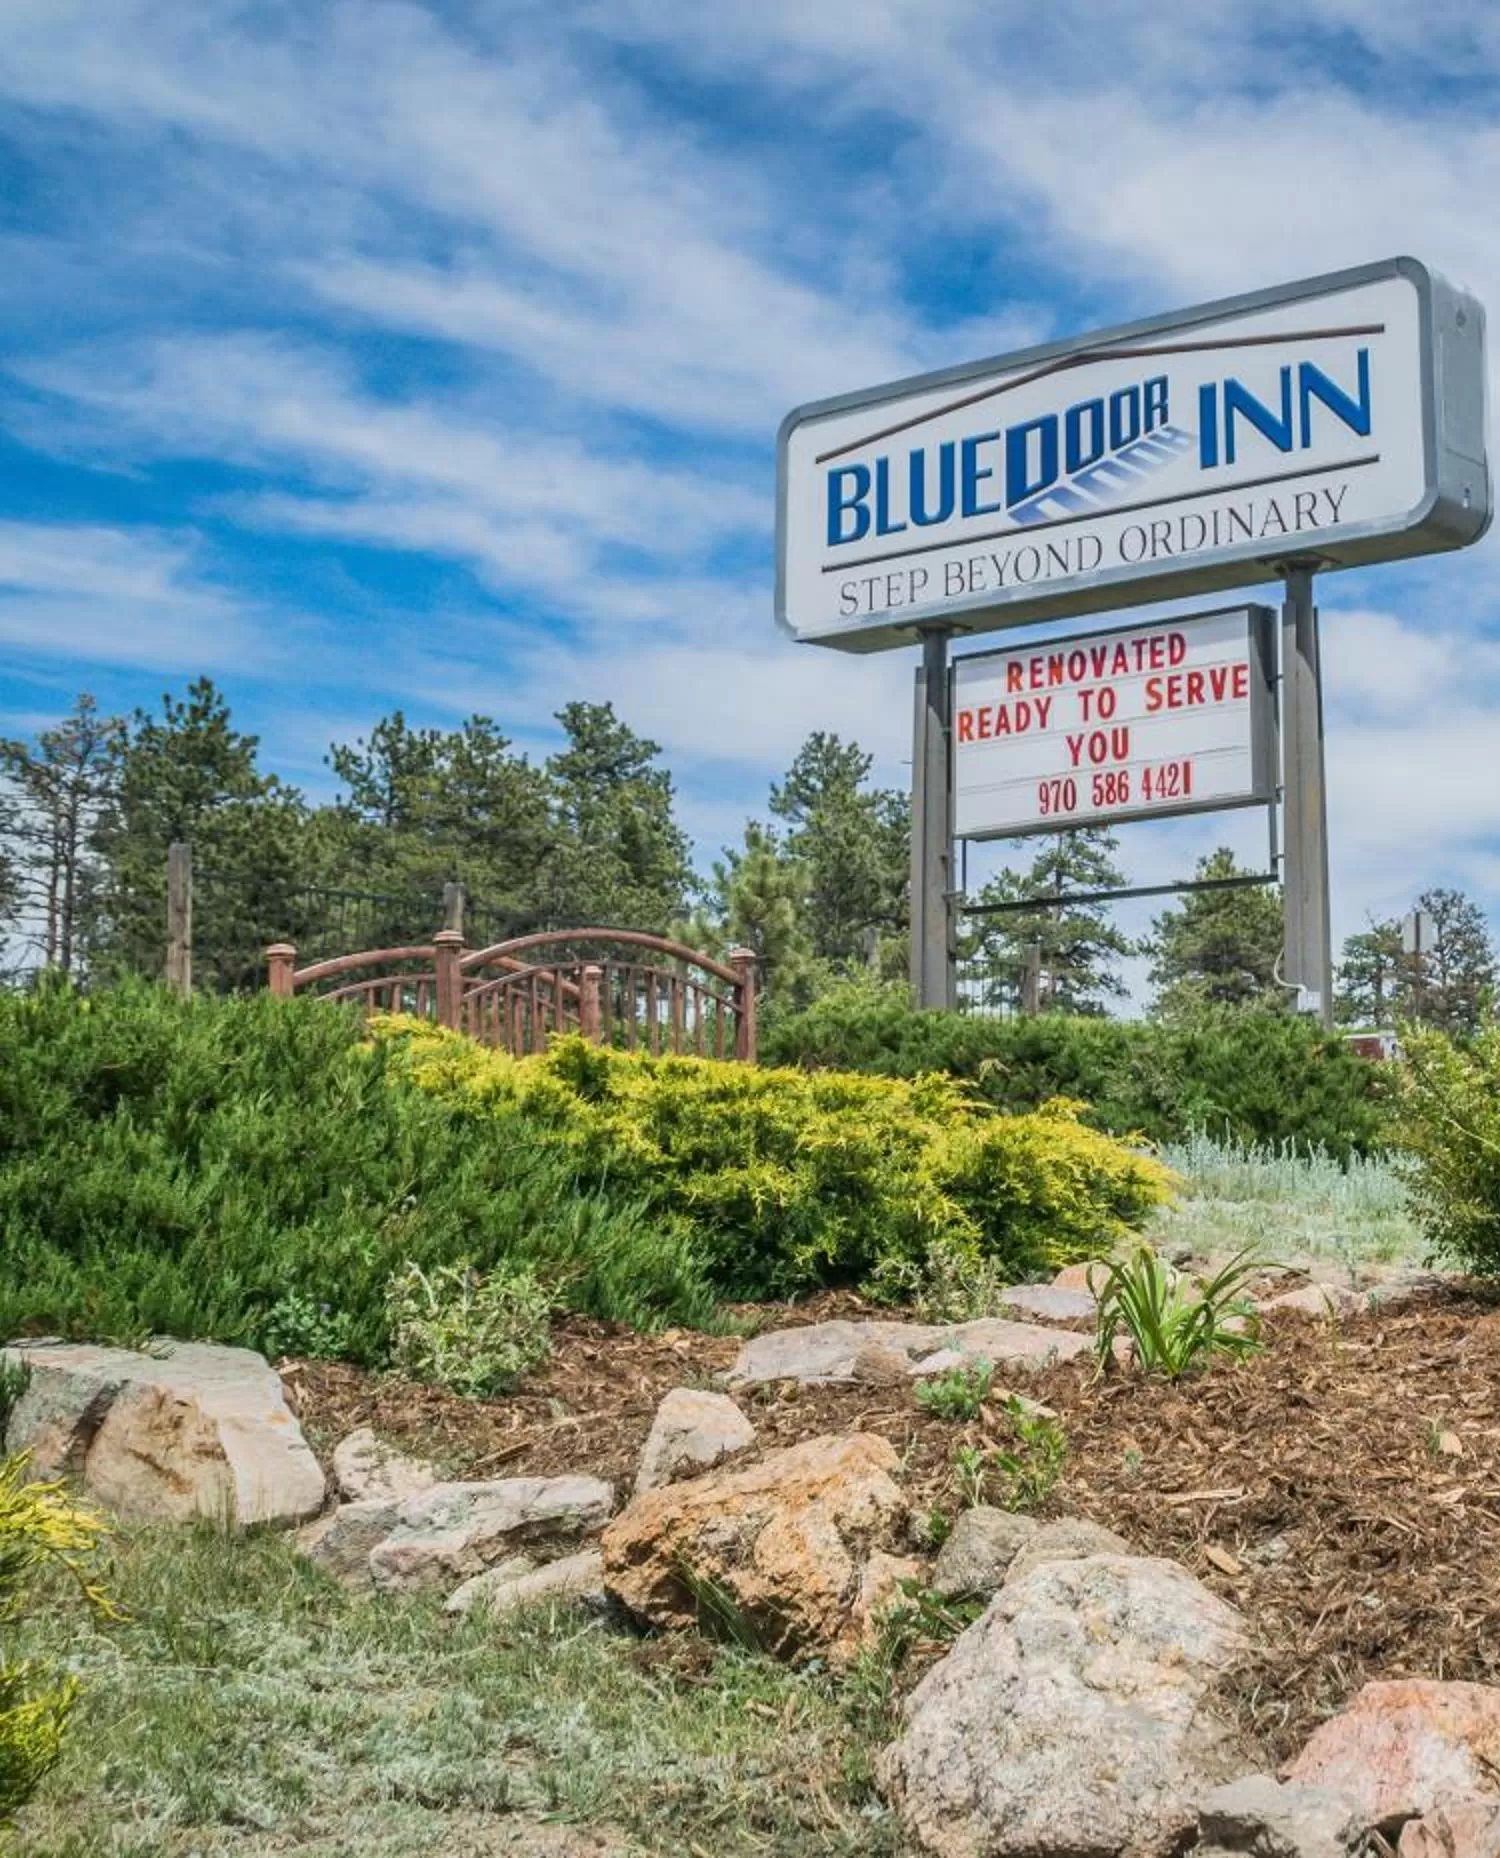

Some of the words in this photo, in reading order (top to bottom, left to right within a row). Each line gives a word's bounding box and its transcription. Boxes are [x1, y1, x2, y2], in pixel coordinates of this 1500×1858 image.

[1198, 348, 1371, 469] INN
[839, 568, 929, 617] STEP
[943, 534, 1103, 598] BEYOND
[1118, 484, 1349, 562] ORDINARY
[1007, 632, 1187, 691] RENOVATED
[957, 695, 1052, 742] READY
[1078, 687, 1117, 722] TO
[1146, 664, 1249, 711] SERVE
[1066, 727, 1130, 767] YOU
[1039, 777, 1077, 815] 970
[1091, 769, 1130, 806] 586
[1141, 761, 1192, 801] 4421
